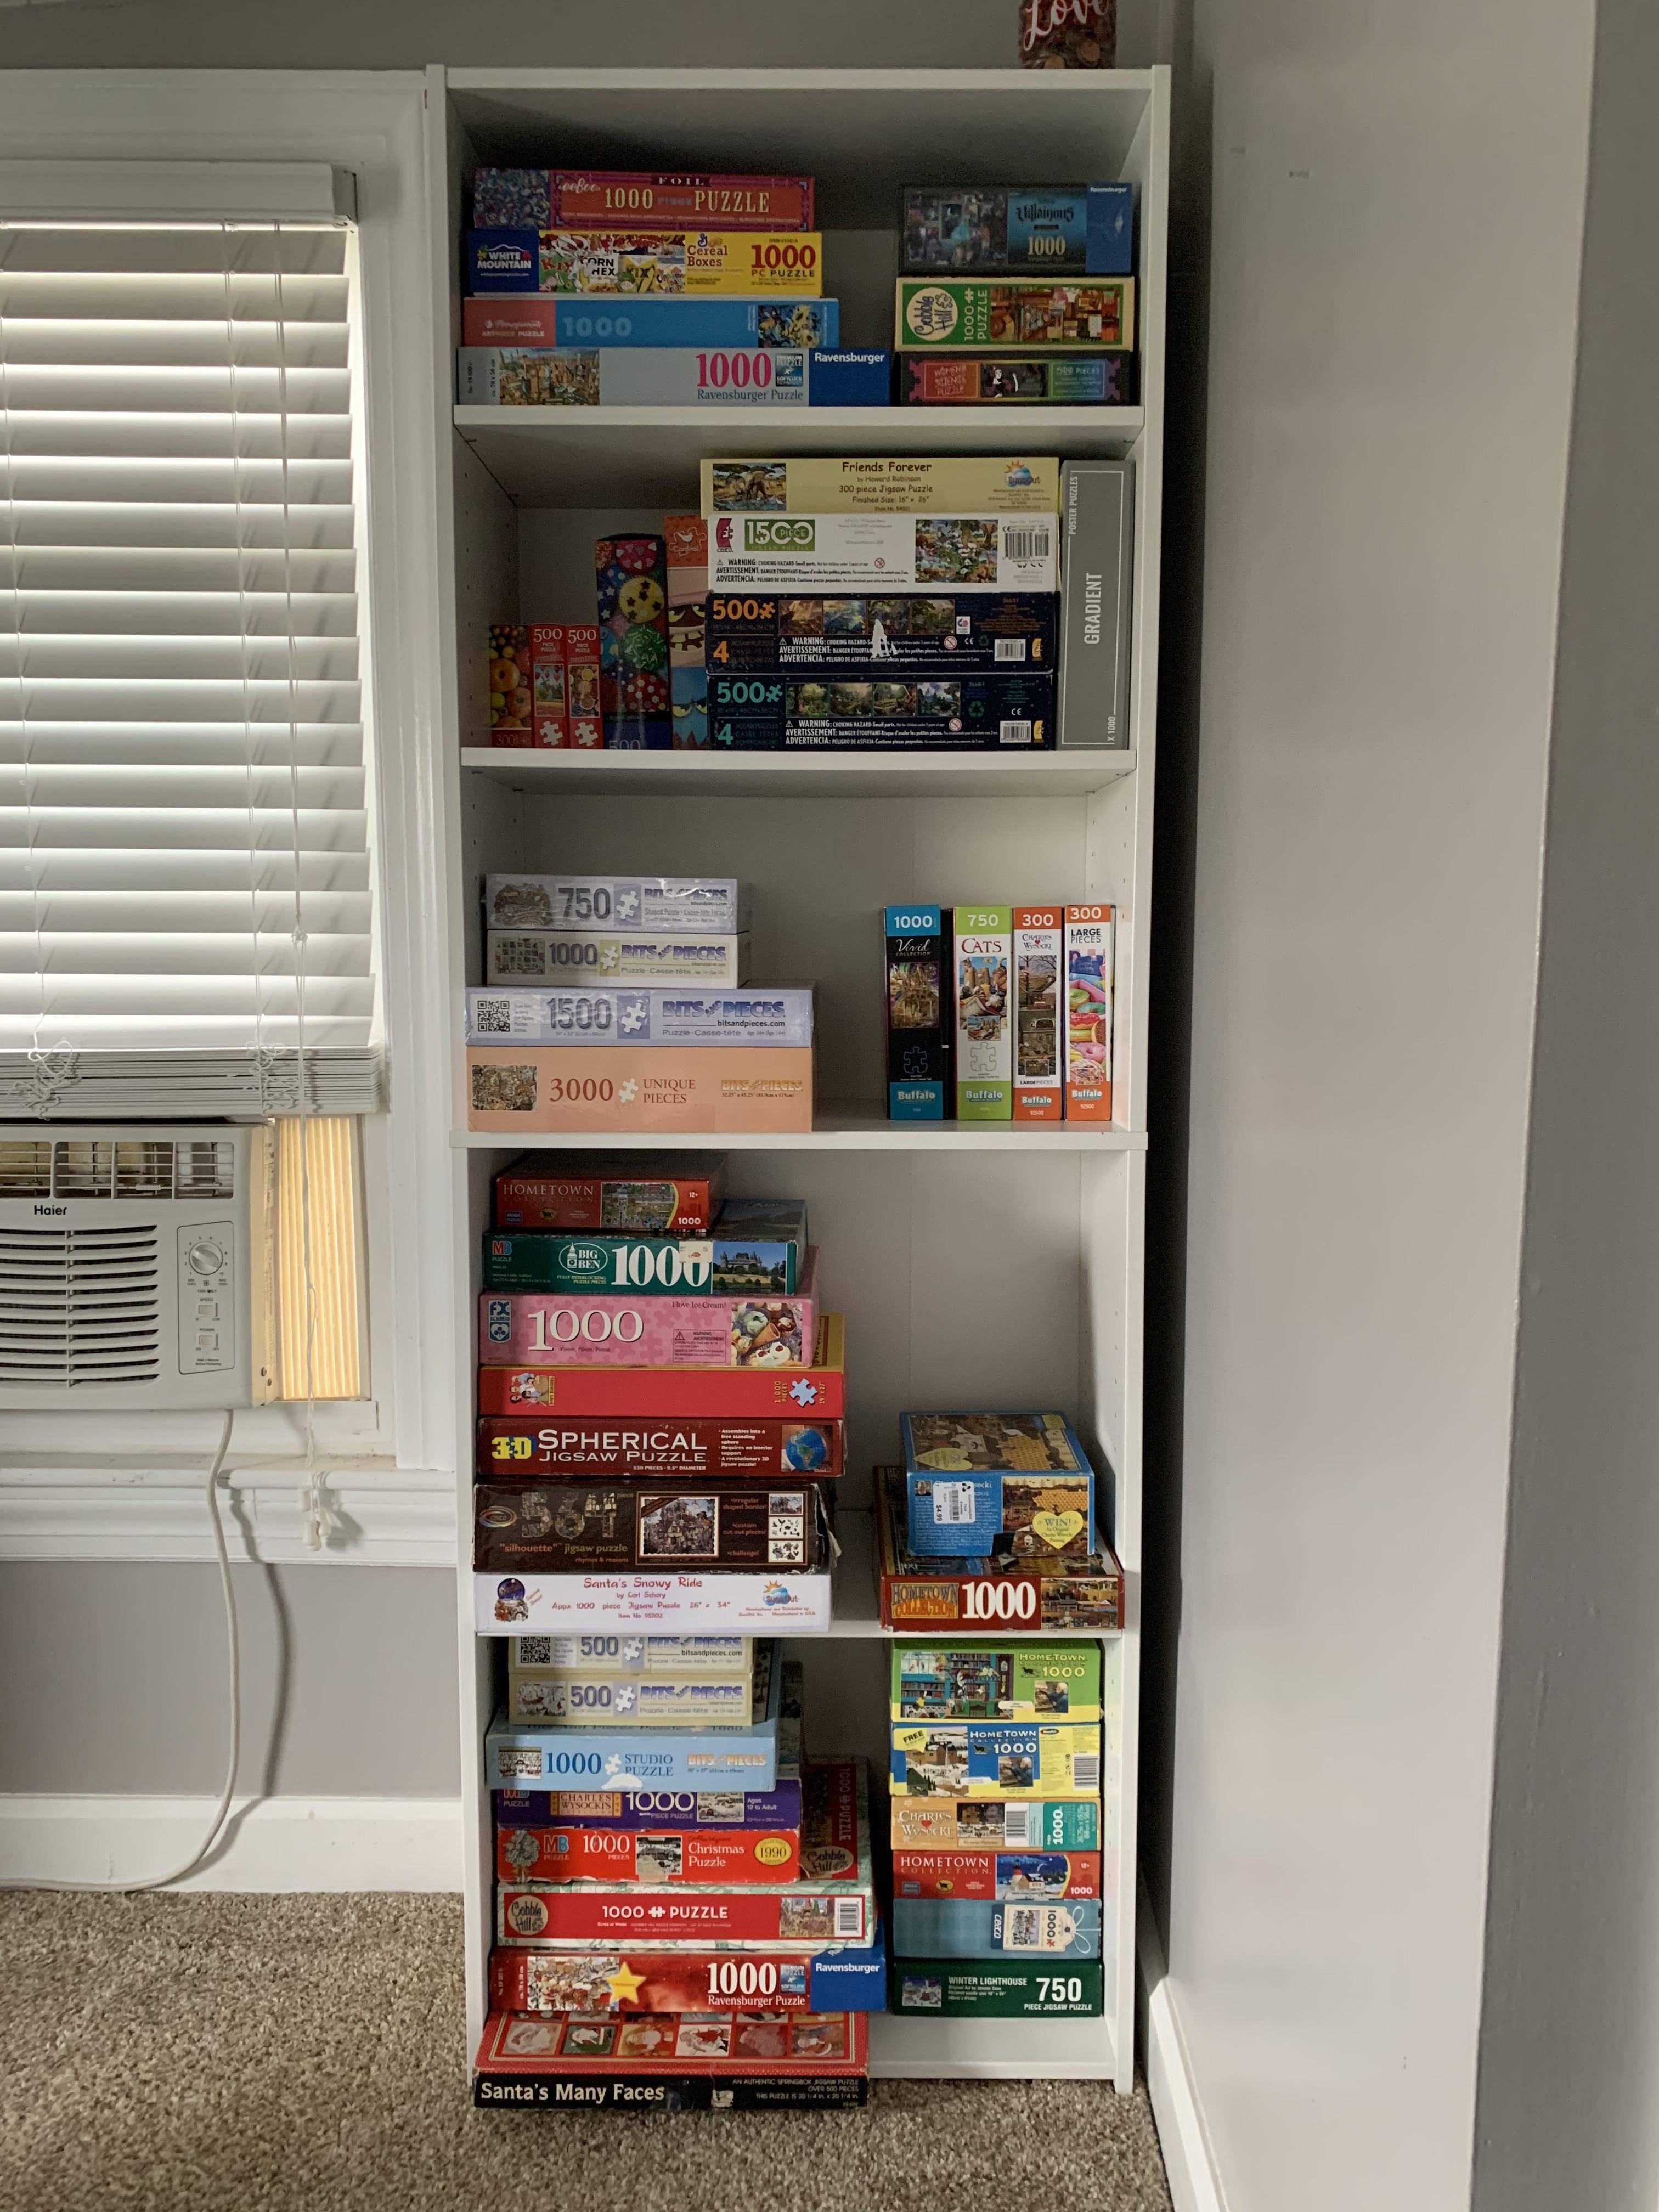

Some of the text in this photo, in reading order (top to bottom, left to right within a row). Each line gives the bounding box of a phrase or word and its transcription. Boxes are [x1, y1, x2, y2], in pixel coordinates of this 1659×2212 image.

[658, 177, 705, 185] FOIL
[605, 187, 769, 213] 1000 PUZZLE
[687, 245, 728, 256] Cereal
[1027, 236, 1066, 256] 1000
[489, 251, 521, 261] WHITE
[687, 256, 723, 267] Boxes
[751, 244, 816, 269] 1000
[477, 260, 532, 269] MOUNTAIN
[914, 296, 935, 336] Cobble
[977, 289, 988, 341] PUZZLE
[563, 316, 632, 337] 1000
[963, 304, 975, 342] 1000
[814, 352, 885, 365] Ravensburger
[696, 352, 772, 388] 1000
[697, 388, 804, 403] Ravensburger Puzzle
[842, 461, 933, 472] Friends Forever
[839, 484, 933, 494] 300 piece Jigsaw Puzzle
[1069, 475, 1079, 536] POSTER PUZZLES
[746, 521, 814, 545] 1500
[780, 529, 806, 537] PIECE
[713, 599, 759, 620] 500
[1084, 572, 1103, 645] GRADIENT
[533, 628, 563, 643] 500
[567, 629, 597, 644] 500
[713, 640, 730, 663] 4
[716, 682, 765, 704] 500
[1107, 716, 1116, 735] 1000
[717, 723, 734, 746] 4
[557, 887, 611, 920] 750
[967, 913, 998, 927] 750
[1022, 913, 1054, 927] 300
[1070, 906, 1102, 921] 300
[894, 915, 933, 929] 1000
[1070, 928, 1102, 937] LARGE
[1070, 935, 1102, 944] PIECES
[620, 944, 727, 961] BITS PIECES
[896, 939, 931, 953] Vivid
[961, 938, 1002, 955] CATS
[548, 943, 597, 966] 1000
[546, 997, 612, 1030] 1500
[662, 1000, 786, 1018] BITS PIECES
[717, 1019, 786, 1028] bitsandpieces.com
[549, 1077, 614, 1102] 3000
[643, 1079, 696, 1092] UNIQUE
[721, 1079, 751, 1091] BITS
[643, 1093, 687, 1104] PIECES
[898, 1090, 935, 1101] Buffalo
[966, 1089, 1003, 1099] Buffalo
[1022, 1096, 1052, 1105] Buffalo
[1071, 1089, 1102, 1098] Buffalo
[503, 1184, 595, 1196] HOMETOWN
[33, 1205, 67, 1216] Haier
[678, 1217, 701, 1226] 1000
[492, 1240, 513, 1256] MB
[578, 1249, 598, 1260] BIG
[578, 1259, 601, 1269] BEN
[702, 1301, 726, 1310] Cream!
[527, 1308, 644, 1351] 1000
[538, 1429, 707, 1451] SPHERICAL
[538, 1451, 706, 1463] JIGSAW PUZZLE
[1043, 1517, 1071, 1527] WIN!
[563, 1543, 628, 1555] jigsaw puzzle
[583, 1576, 703, 1590] Santa's Snowy Ride
[962, 1581, 1036, 1620] 1000
[1042, 1666, 1085, 1678] 1000
[570, 1685, 611, 1707] 500
[902, 1730, 924, 1745] FREE
[969, 1730, 1037, 1739] HOMETOWN
[993, 1743, 1037, 1754] 1000
[545, 1752, 602, 1775] 1000
[624, 1753, 673, 1765] STUDIO
[625, 1767, 674, 1777] PUZZLE
[560, 1793, 612, 1802] CHARLES
[625, 1791, 695, 1812] 1000
[561, 1802, 612, 1810] WYSOCKI'S
[1052, 1809, 1064, 1845] 1000
[544, 1835, 569, 1853] MB
[583, 1835, 630, 1854] 1000
[688, 1842, 745, 1854] Christmas
[759, 1847, 787, 1858] 1990
[689, 1855, 726, 1867] Puzzle
[900, 1857, 988, 1868] HOMETOWN
[1070, 1887, 1093, 1895] 1000
[511, 1901, 542, 1917] Cobble
[602, 1906, 729, 1919] 1000 PUZZLE
[1047, 1910, 1057, 1938] 1000
[815, 1962, 881, 1974] Ravensburger
[707, 1962, 777, 1994] 1000
[948, 1976, 1028, 1986] WINTER LIGHTHOUSE
[1036, 1977, 1082, 2002] 750
[708, 1995, 806, 2008] Ravensburger Puzzle
[481, 2083, 665, 2104] Santa's Many Faces
